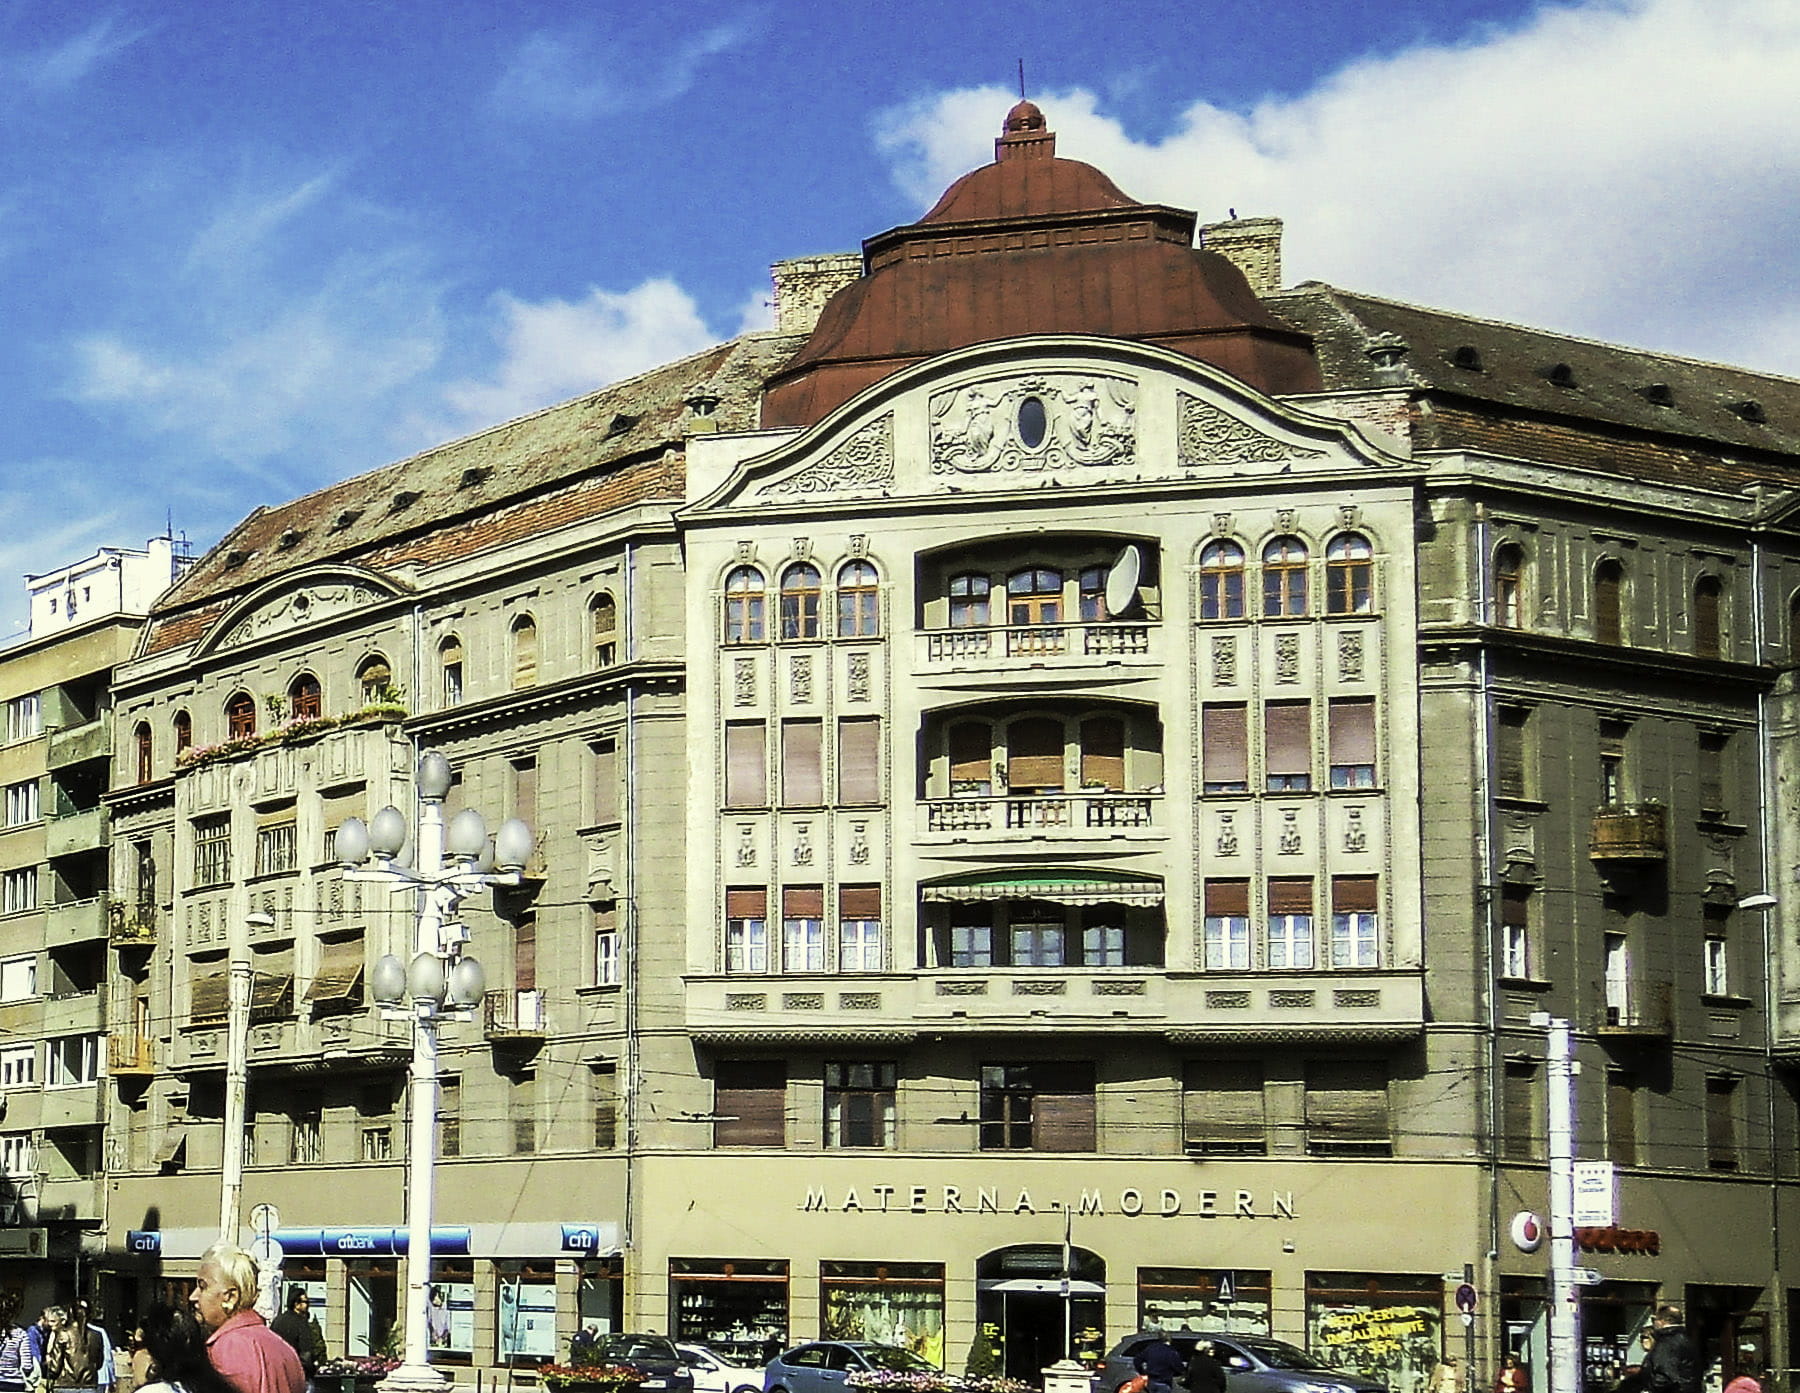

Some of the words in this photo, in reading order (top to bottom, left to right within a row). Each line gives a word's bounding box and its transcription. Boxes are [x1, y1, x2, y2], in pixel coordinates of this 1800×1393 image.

[134, 1237, 155, 1251] citi
[337, 1233, 376, 1250] citibank
[569, 1231, 592, 1248] citi
